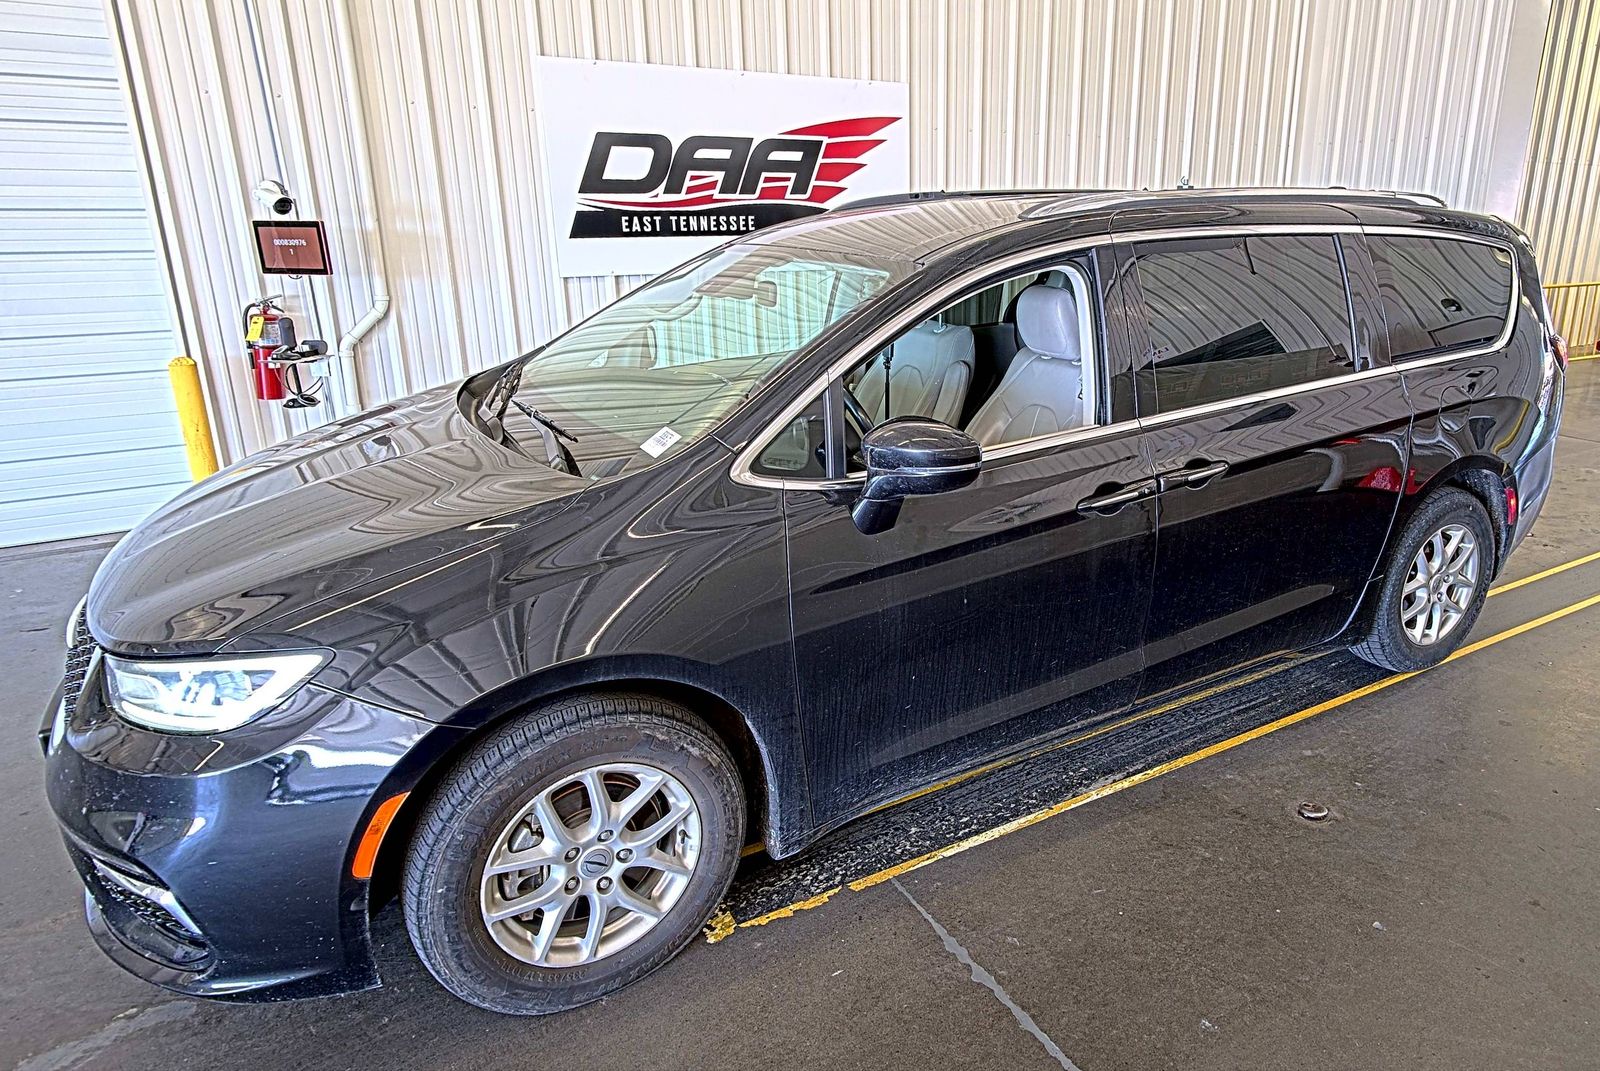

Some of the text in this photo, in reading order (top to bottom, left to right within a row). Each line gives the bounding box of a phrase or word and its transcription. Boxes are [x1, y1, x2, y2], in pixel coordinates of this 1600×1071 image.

[578, 132, 825, 195] DAA
[621, 215, 756, 232] EAST TENNESSEE
